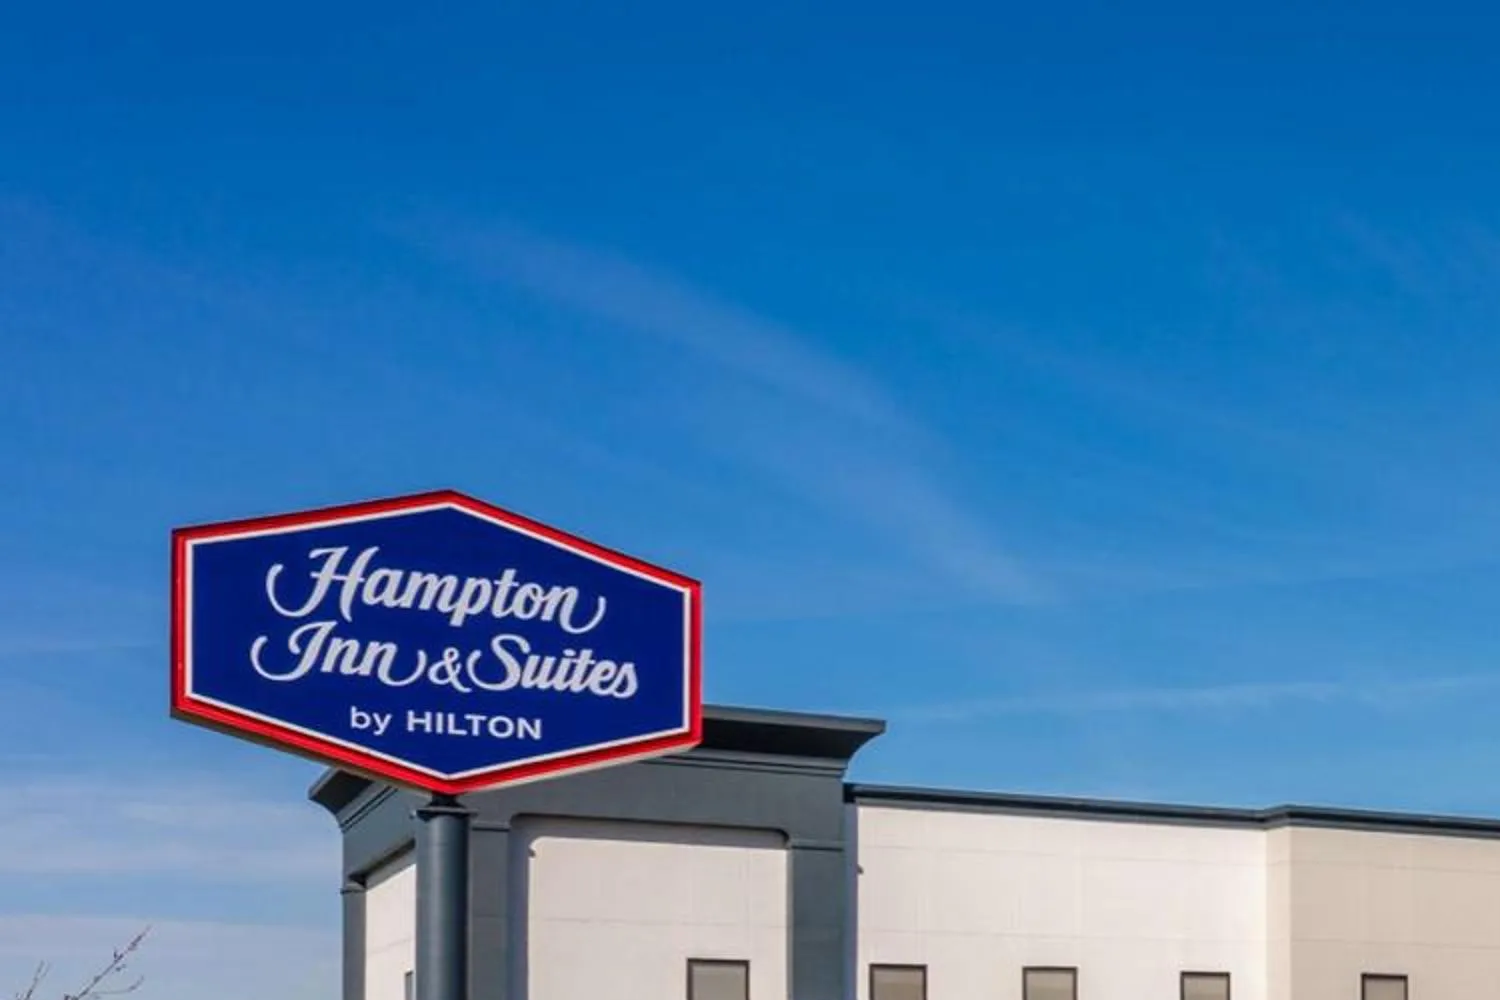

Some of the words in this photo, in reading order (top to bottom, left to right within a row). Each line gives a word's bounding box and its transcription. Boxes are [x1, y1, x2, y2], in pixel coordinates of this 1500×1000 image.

[265, 546, 606, 634] Hampton
[250, 620, 427, 687] Inn
[427, 647, 472, 693] &
[466, 634, 639, 699] Suites
[350, 706, 392, 736] by
[406, 710, 542, 741] HILTON
